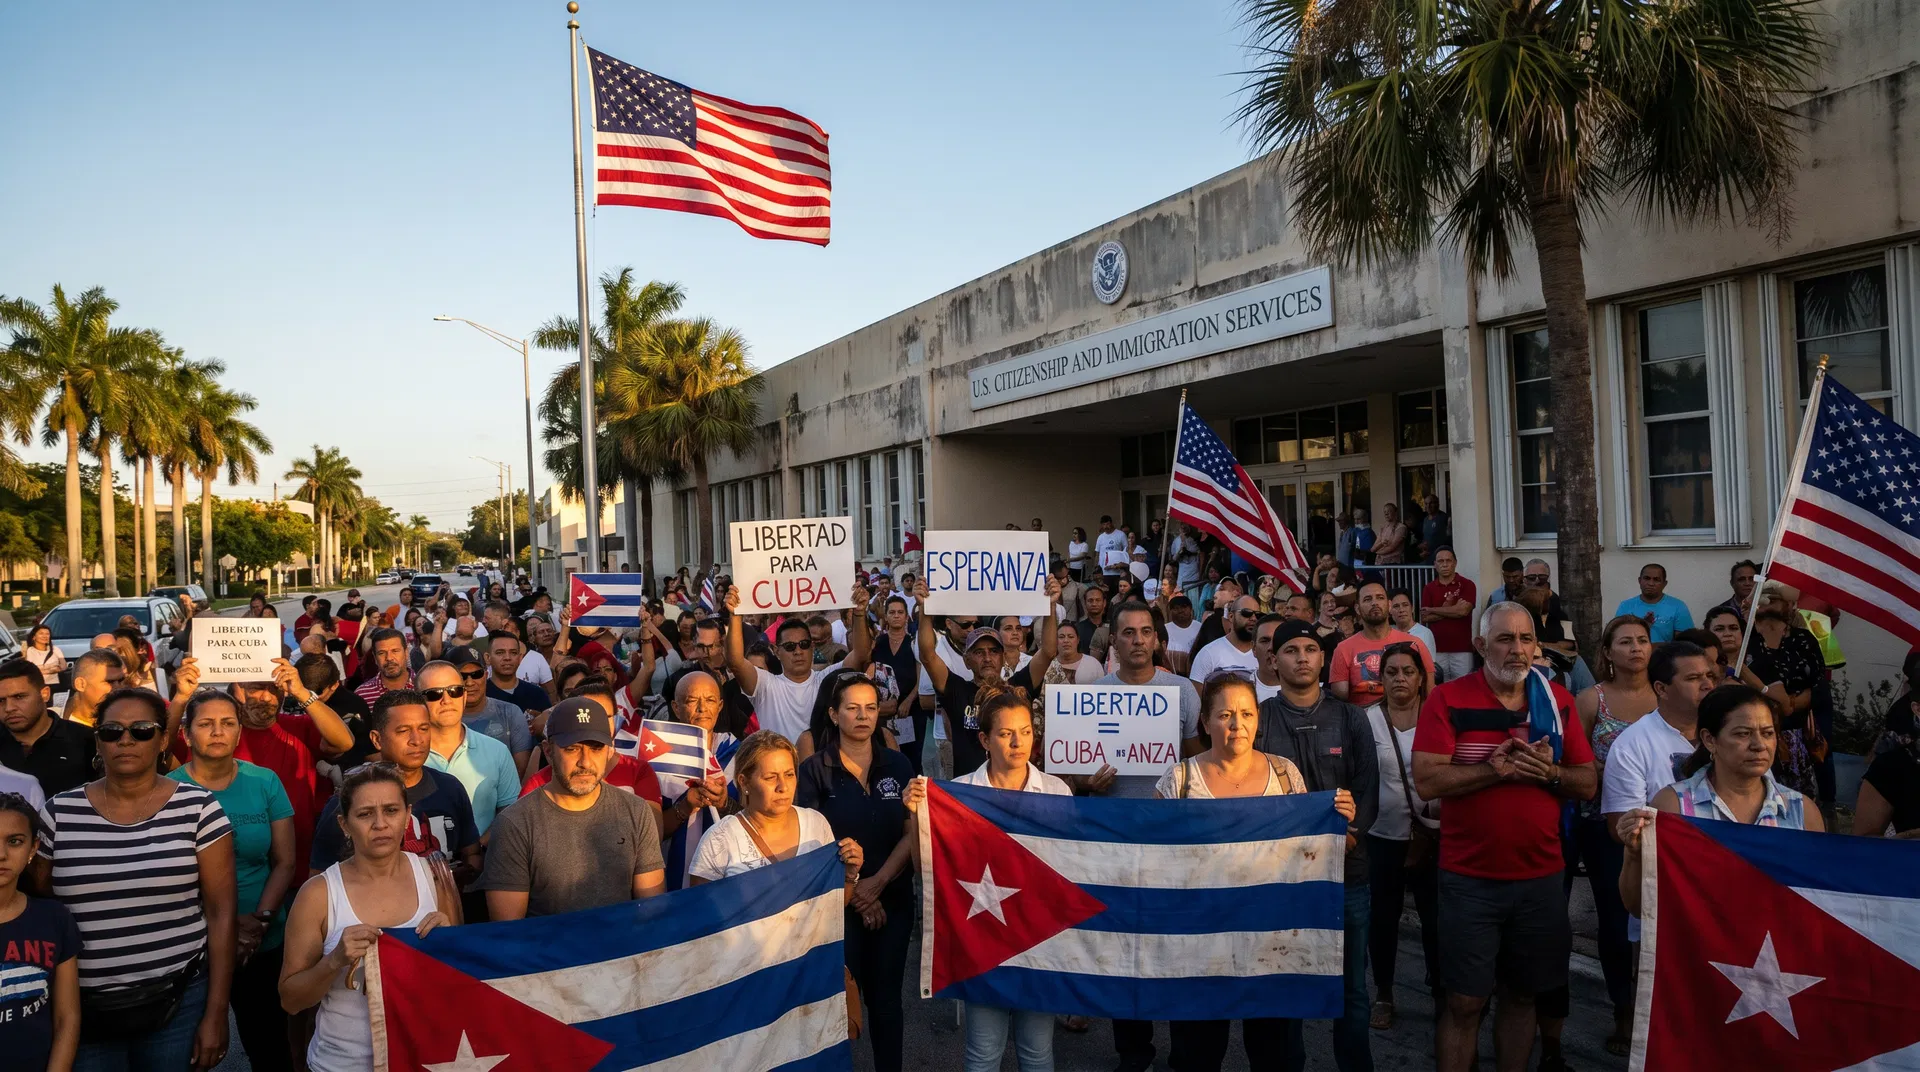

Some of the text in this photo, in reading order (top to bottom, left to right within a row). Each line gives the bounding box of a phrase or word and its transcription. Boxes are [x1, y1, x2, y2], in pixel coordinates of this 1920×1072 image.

[972, 285, 1322, 398] U.S. CITIZENSHIP AND IMMIGRATION SERVICES
[739, 523, 846, 552] LIBERTAD
[770, 554, 818, 574] PARA
[927, 551, 1048, 591] ESPERANZA
[752, 576, 837, 609] CUBA
[211, 626, 264, 634] LIBERTAD
[207, 639, 268, 647] PARA CUBA
[1056, 691, 1168, 716] LIBERTAD
[1049, 739, 1107, 764] CUBA
[1127, 742, 1178, 764] ANZA
